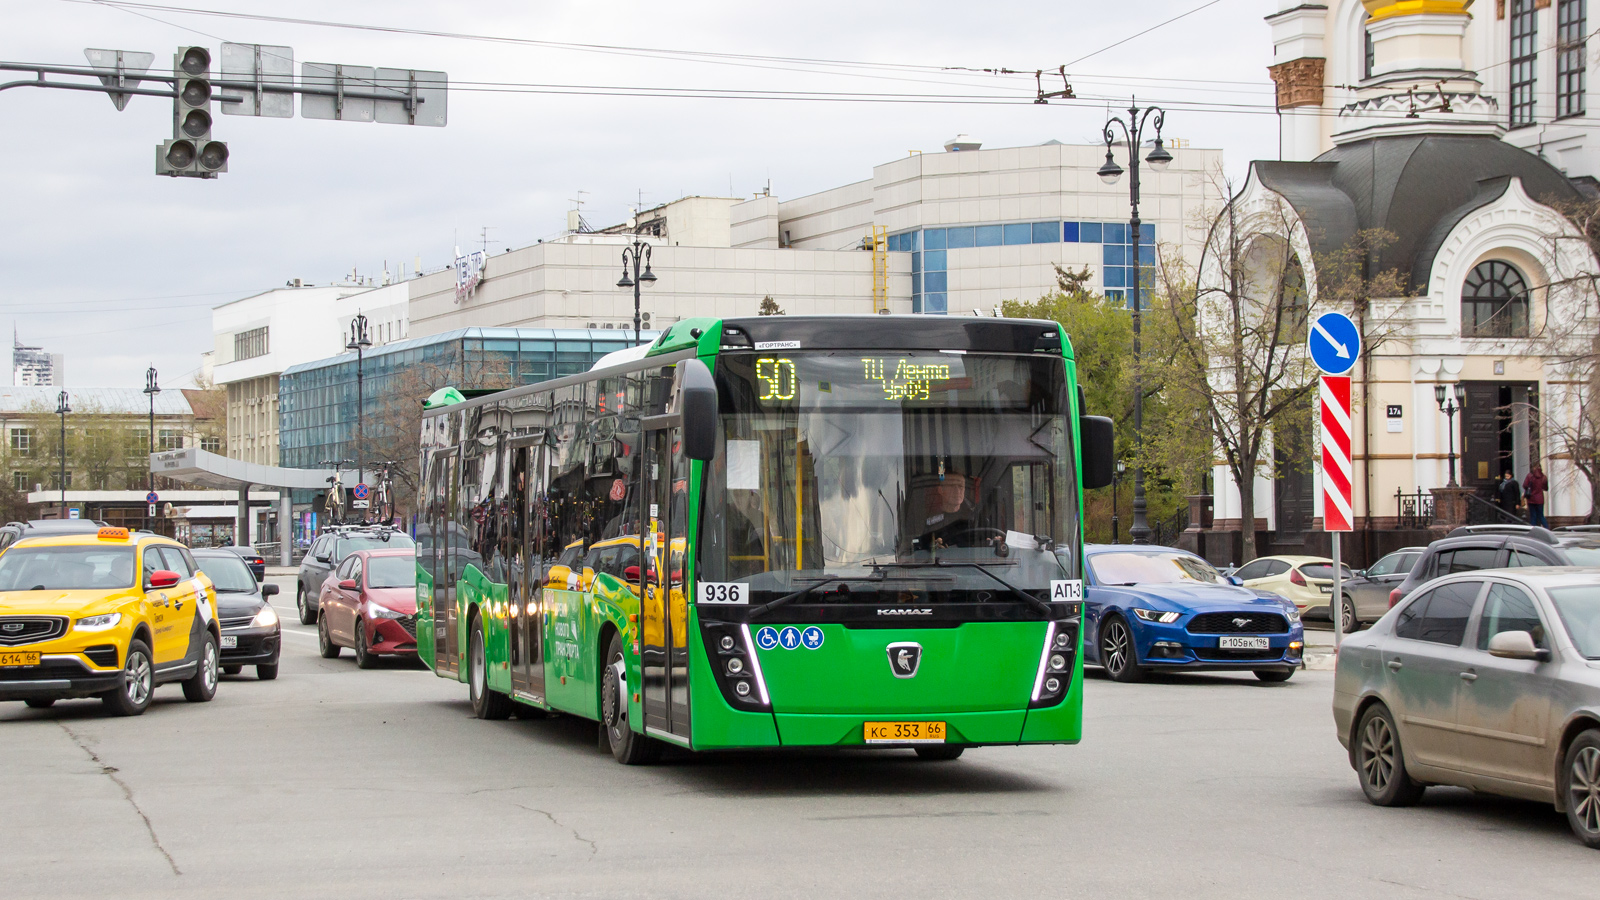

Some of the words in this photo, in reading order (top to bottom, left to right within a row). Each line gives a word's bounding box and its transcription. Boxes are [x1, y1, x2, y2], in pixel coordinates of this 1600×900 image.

[455, 251, 484, 285] ТЕАТР
[758, 341, 797, 349] «ГОРТРАНС»
[861, 358, 884, 380] ТЦ
[894, 358, 950, 380] Лента
[755, 358, 796, 400] 50
[882, 379, 930, 400] УрФУ
[705, 584, 740, 602] 936
[1054, 583, 1081, 598] АП-3
[877, 608, 933, 616] KAMAZ
[1255, 638, 1267, 646] 196
[26, 653, 37, 661] 66
[871, 727, 888, 738] КС
[894, 723, 920, 738] 353
[927, 723, 941, 734] 66
